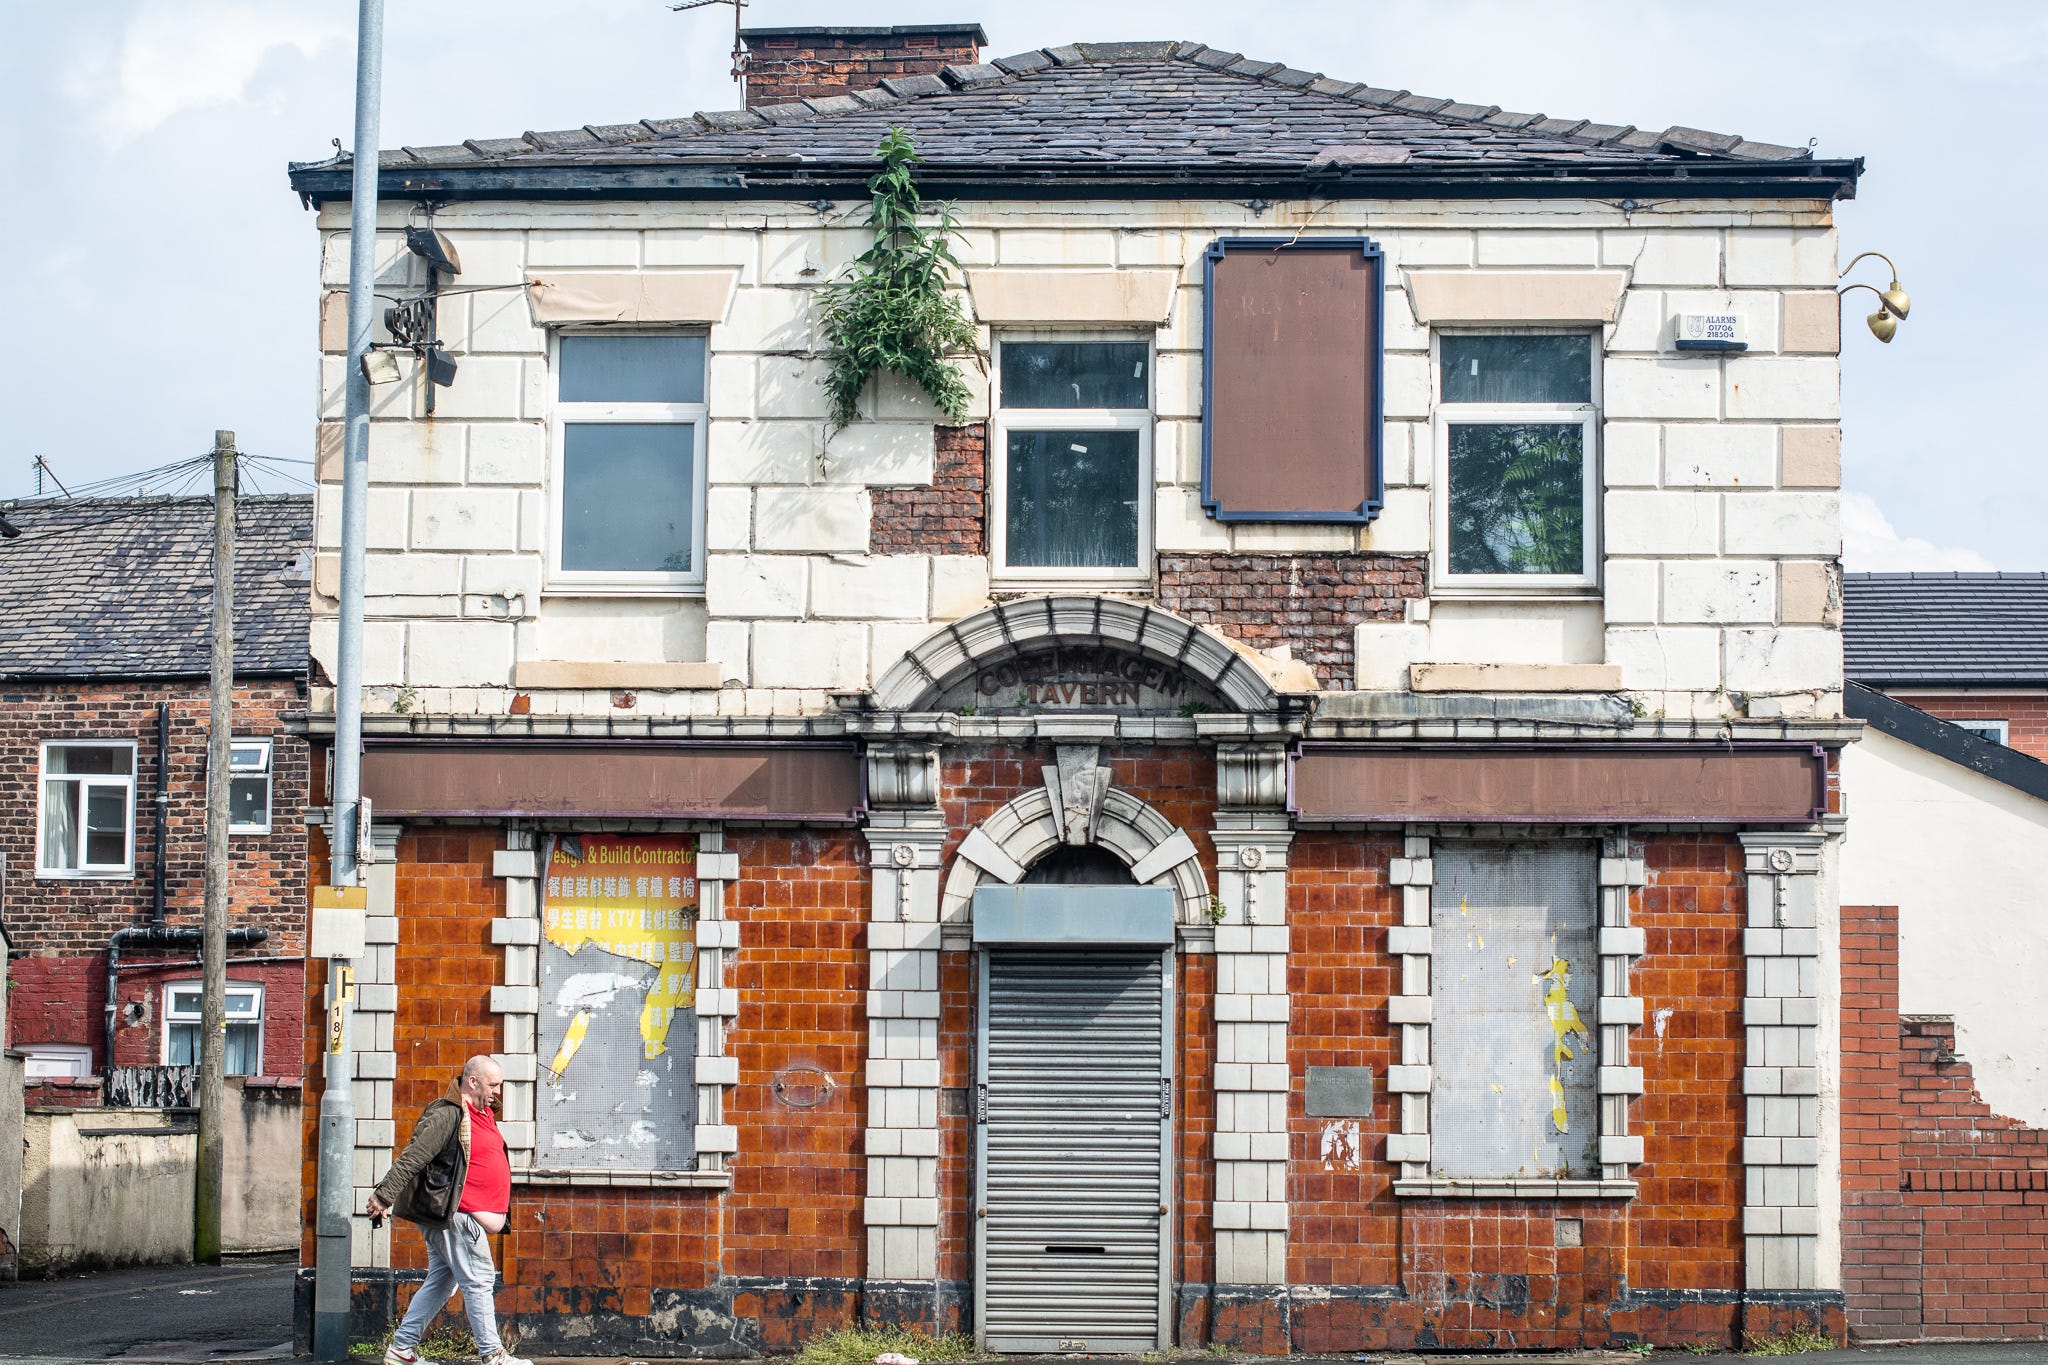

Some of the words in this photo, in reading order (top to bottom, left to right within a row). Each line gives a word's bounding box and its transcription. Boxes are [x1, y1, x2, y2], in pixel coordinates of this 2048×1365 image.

[1705, 316, 1737, 324] ALARMS
[978, 651, 1185, 697] COPENHAGEN
[1027, 682, 1140, 705] TAVERN
[588, 845, 597, 864] &
[600, 845, 631, 864] Build
[633, 845, 695, 864] Contracto
[608, 910, 635, 929] KTV
